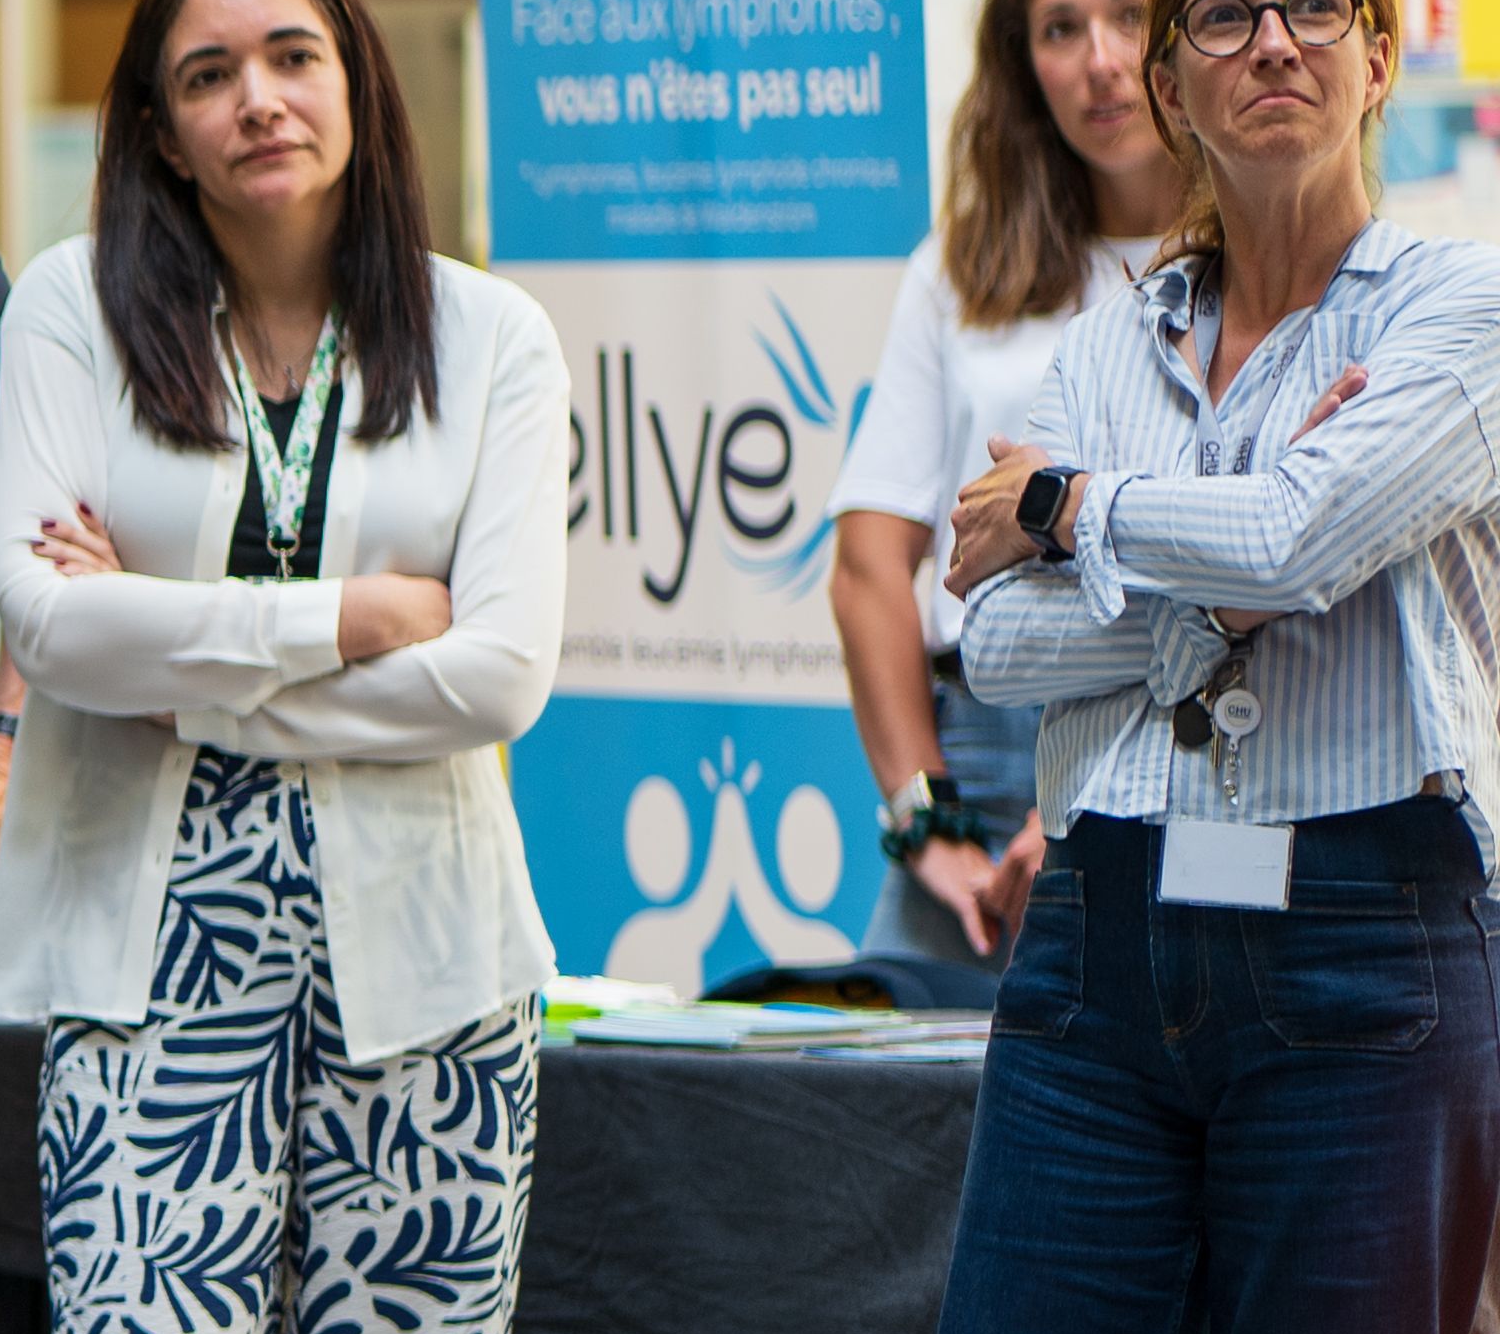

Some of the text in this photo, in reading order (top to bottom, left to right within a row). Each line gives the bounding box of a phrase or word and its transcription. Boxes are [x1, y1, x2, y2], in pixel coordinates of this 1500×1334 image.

[536, 50, 881, 133] vous n'êtes pas seul
[1205, 441, 1220, 475] CHU
[1233, 437, 1250, 474] CHU
[1228, 705, 1251, 717] CHU
